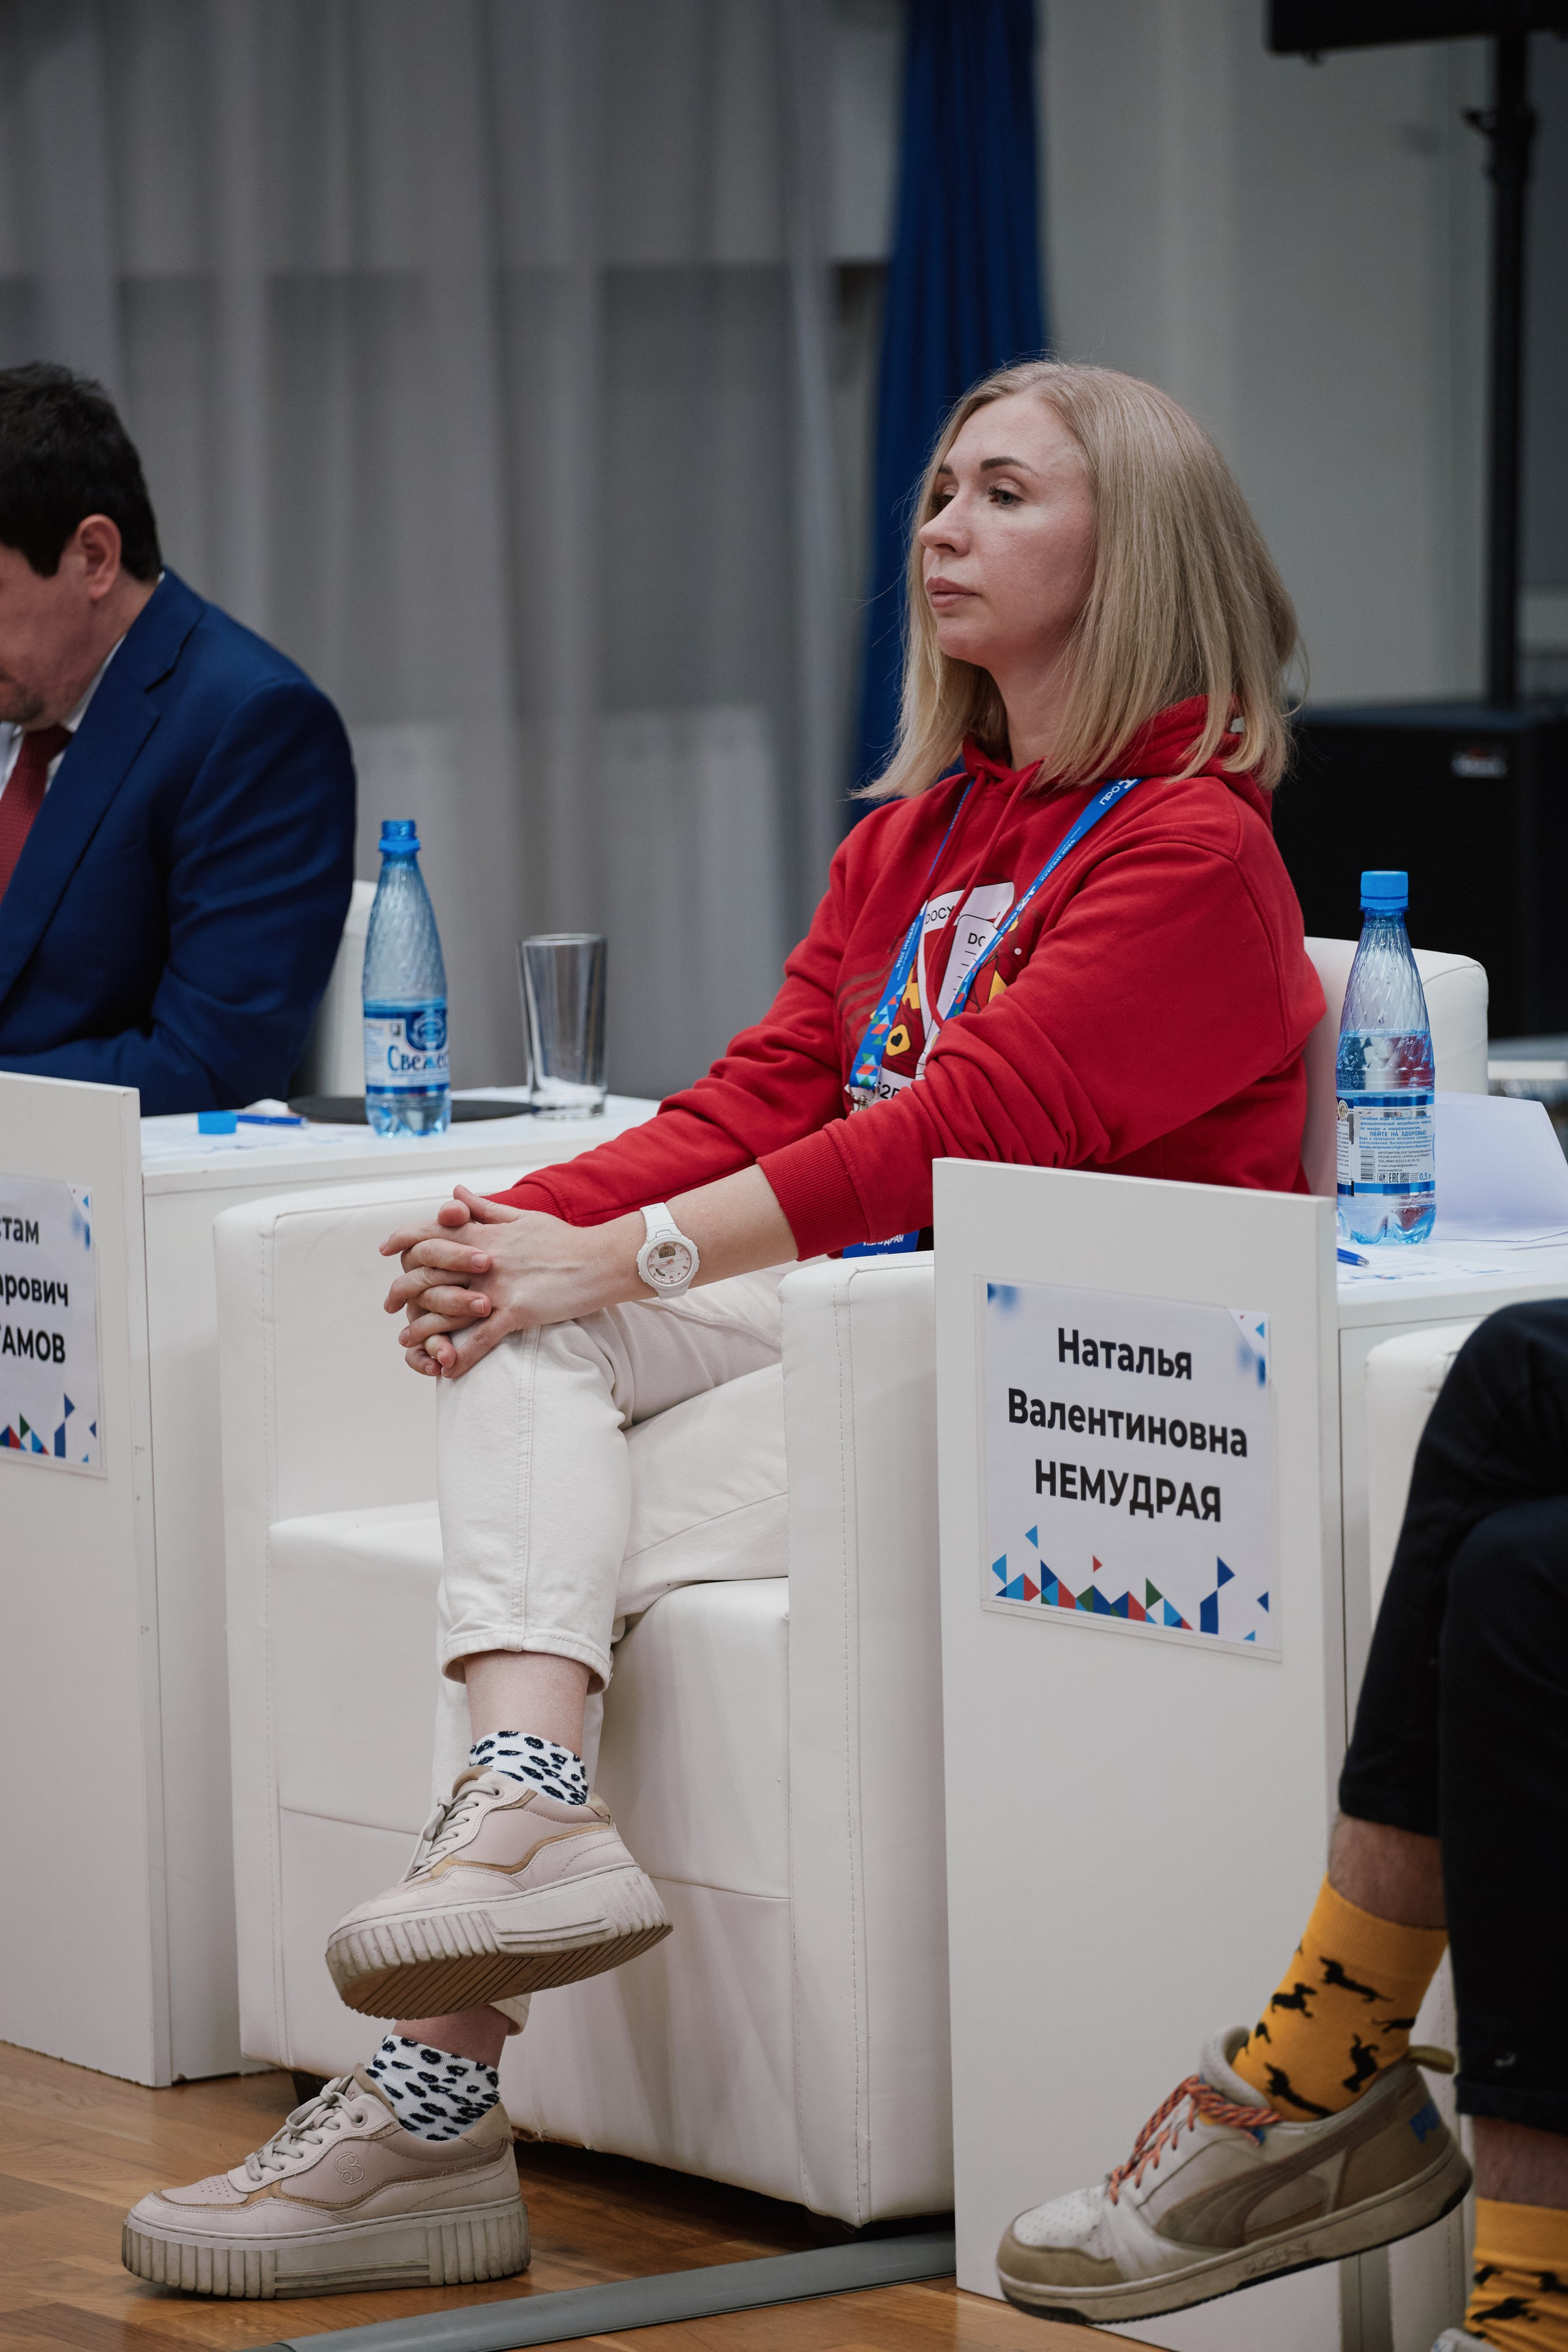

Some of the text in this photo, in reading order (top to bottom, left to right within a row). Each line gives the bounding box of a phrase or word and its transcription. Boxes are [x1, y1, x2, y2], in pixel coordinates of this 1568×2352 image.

[1099, 786, 1120, 805] ПРО
[1419, 1172, 1428, 1181] 0,5
[0, 1216, 39, 1245] там
[0, 1324, 66, 1363] АМОВ
[1058, 1327, 1192, 1381] Наталья
[1008, 1388, 1248, 1458] Валентиновна
[1035, 1459, 1221, 1523] НЕМУДРАЯ
